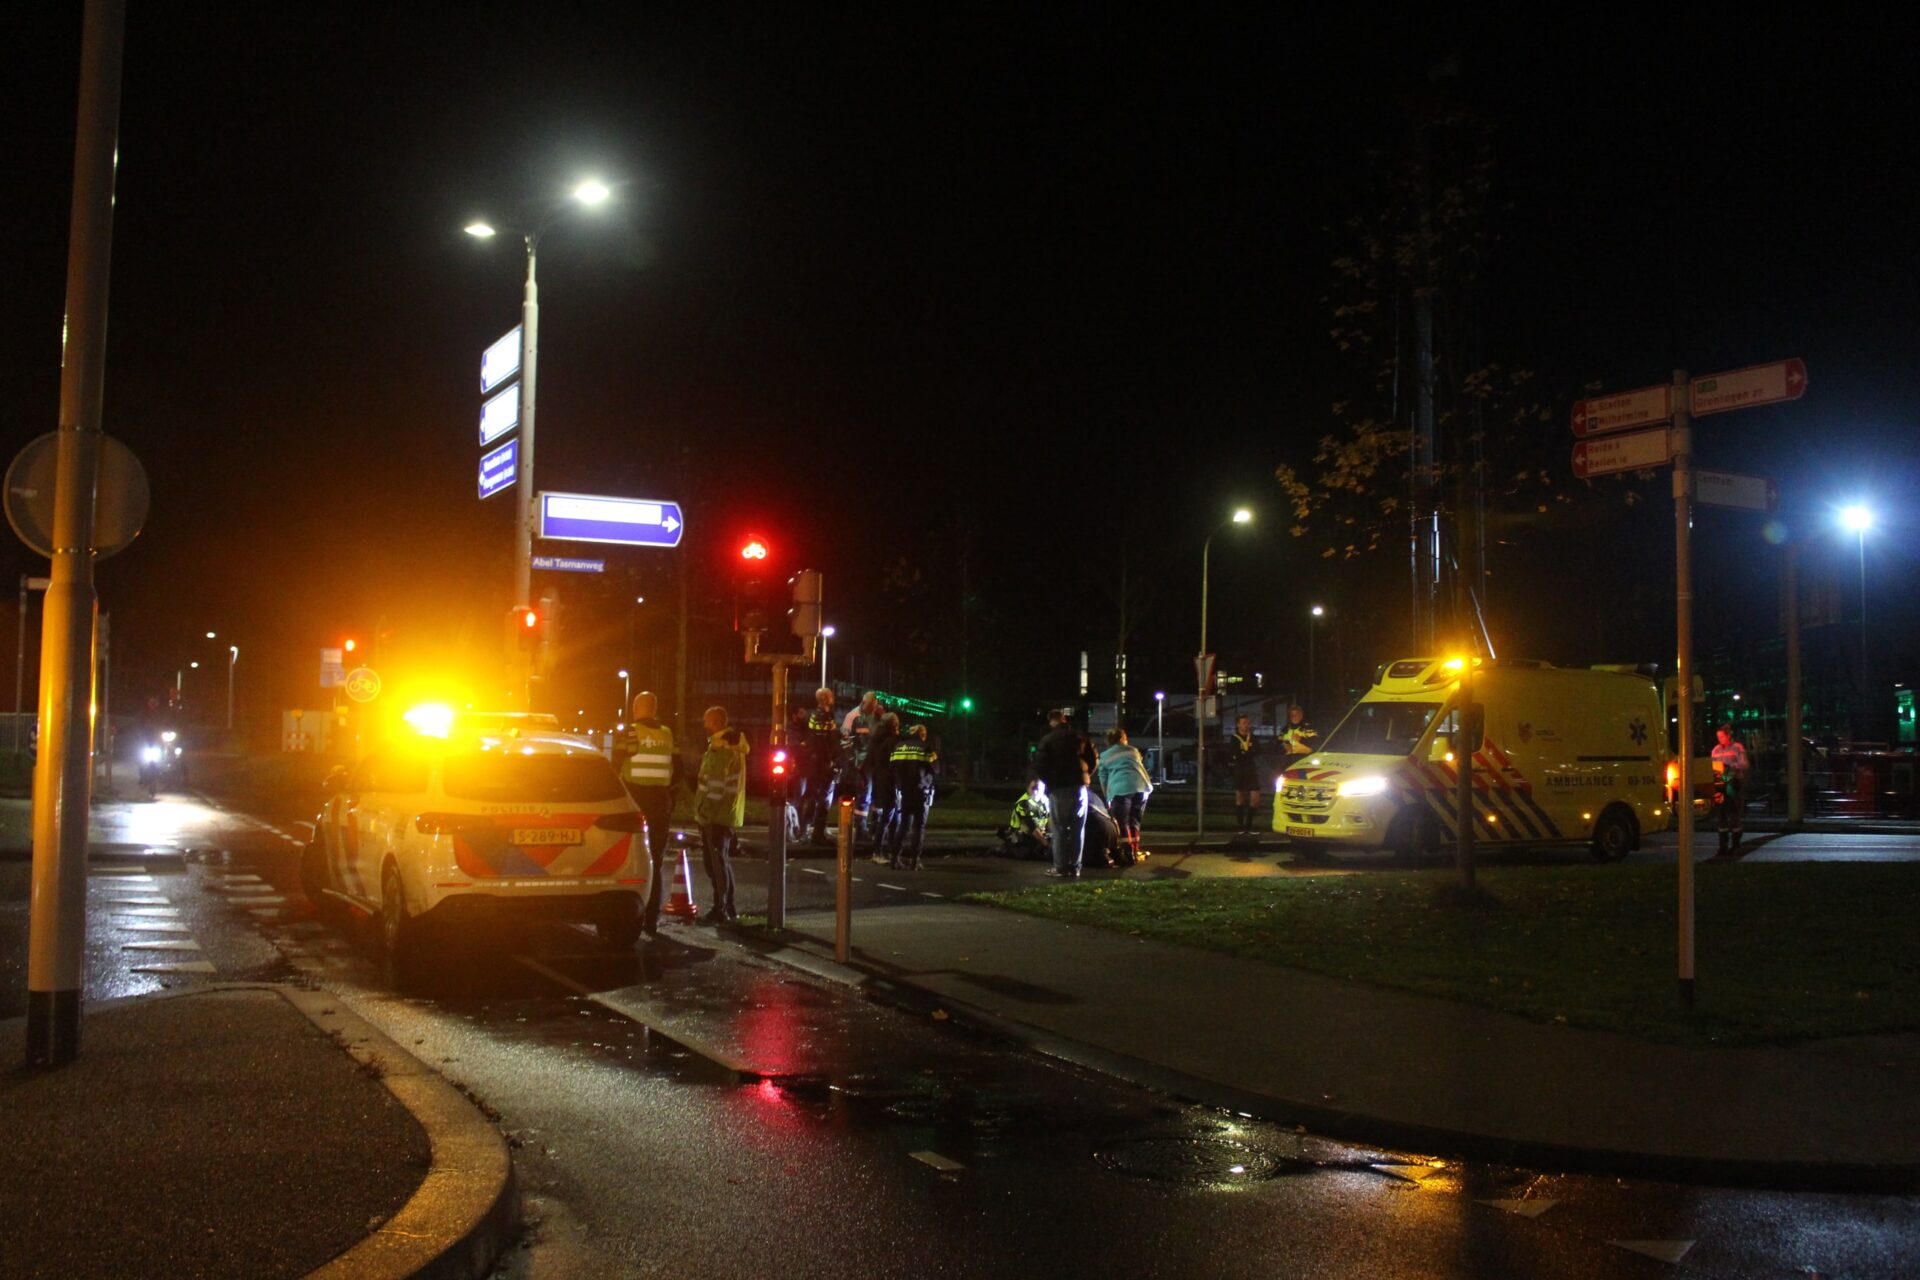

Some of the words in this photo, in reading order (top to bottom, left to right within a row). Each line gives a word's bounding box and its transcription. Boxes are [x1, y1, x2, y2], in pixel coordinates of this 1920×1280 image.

[1599, 398, 1632, 411] Station
[1695, 391, 1749, 407] Groningen
[533, 557, 553, 568] Abel
[554, 558, 604, 572] Tasmanweg
[1545, 775, 1615, 787] AMBULANCE
[481, 805, 536, 814] POLITIE
